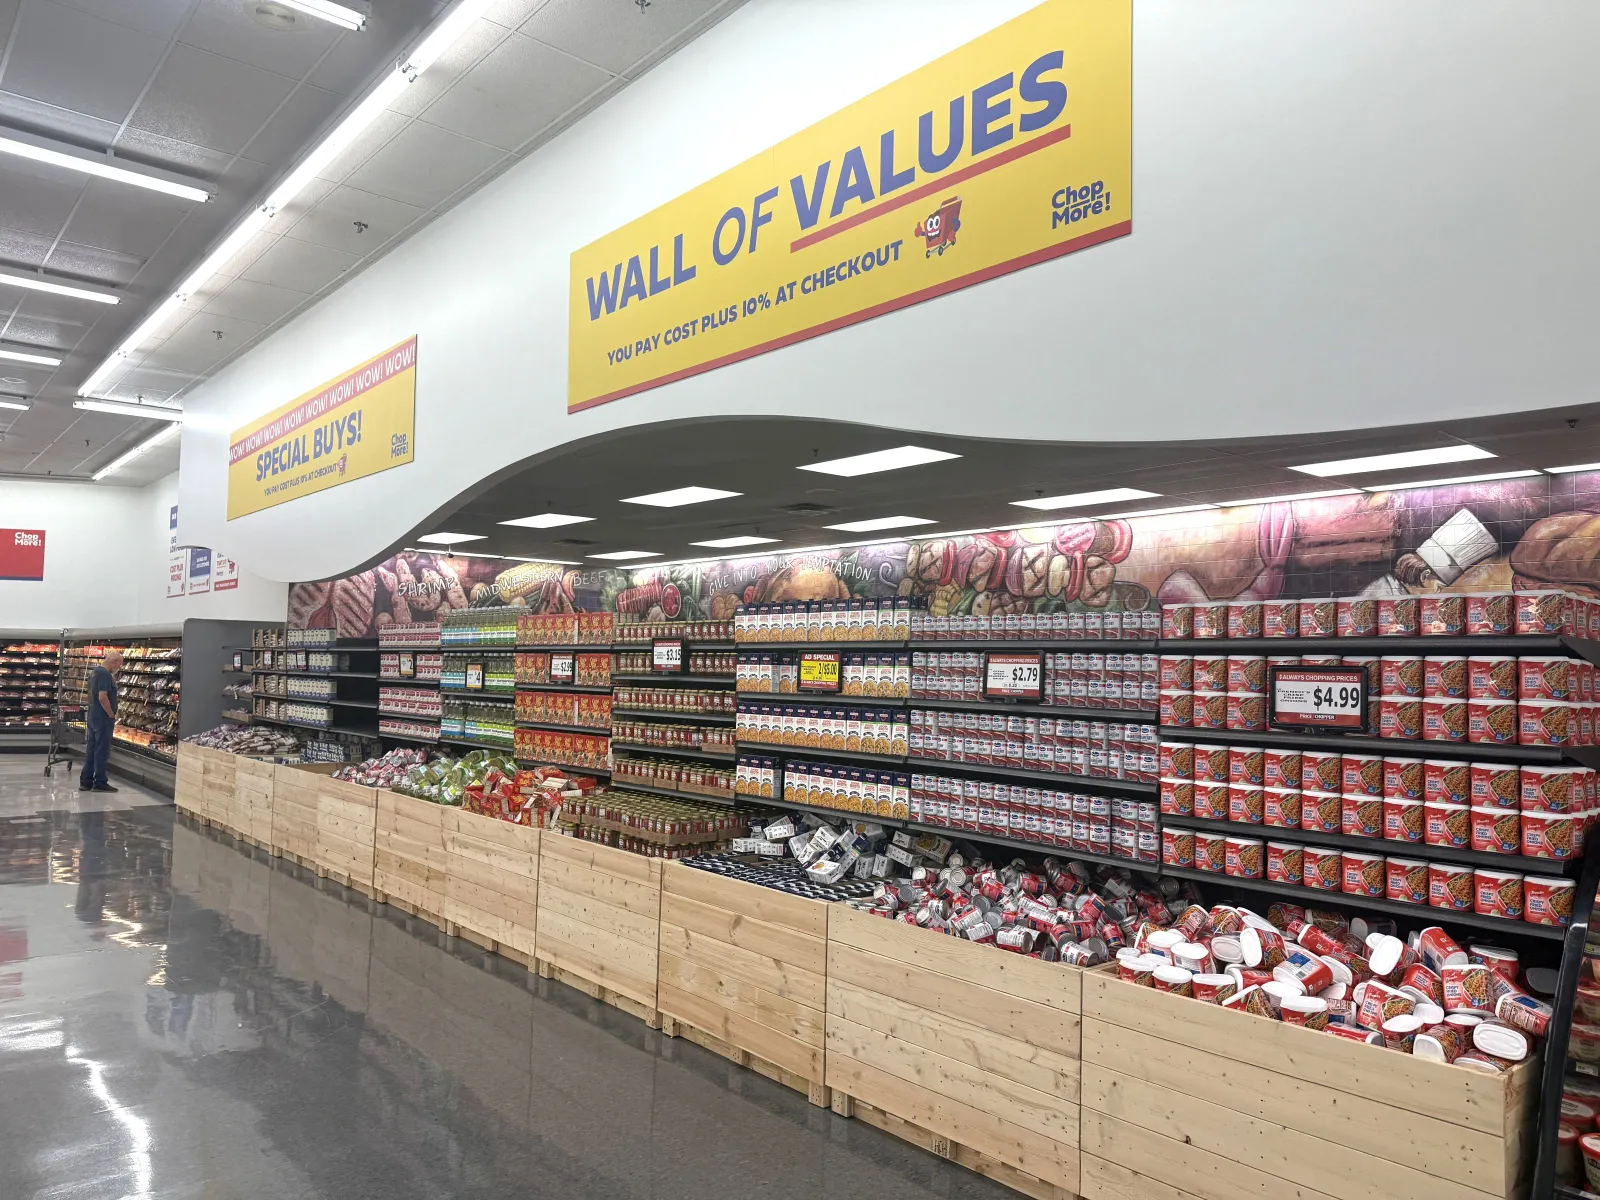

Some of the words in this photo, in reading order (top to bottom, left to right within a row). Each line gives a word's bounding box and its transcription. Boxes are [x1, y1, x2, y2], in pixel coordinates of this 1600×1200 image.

[585, 233, 697, 321] WALL
[713, 186, 779, 266] OF
[789, 50, 1068, 231] VALUES
[1052, 180, 1104, 210] Chop
[1052, 191, 1112, 230] More!
[607, 343, 633, 366] YOU
[635, 333, 661, 358] PAY
[664, 319, 698, 347] COST
[701, 305, 738, 334] PLUS
[742, 293, 771, 318] 10%
[775, 281, 797, 306] AT
[800, 240, 904, 296] CHECKOUT
[246, 435, 262, 451] WOW!
[264, 425, 283, 441] WOW!
[284, 411, 304, 431] WOW!
[305, 397, 328, 420] WOW!
[330, 383, 354, 406] WOW!
[356, 367, 382, 393] WOW!
[384, 345, 415, 374] WOW!
[256, 435, 309, 482] SPECIAL
[313, 409, 362, 460] BUYS!
[391, 433, 407, 447] Chop
[391, 442, 409, 458] More!
[280, 478, 289, 492] COST
[314, 463, 338, 480] CHECKOUT
[15, 532, 38, 540] Chop
[398, 577, 454, 597] SHRIMP
[476, 569, 564, 600] MIDWESTERN
[570, 570, 604, 587] BEEF
[709, 575, 729, 596] GIVE
[764, 555, 795, 573] YOUR
[799, 555, 872, 581] TEMPTATION
[667, 649, 680, 661] $3.15
[1012, 666, 1038, 683] $2.79
[1313, 686, 1359, 711] $4.99
